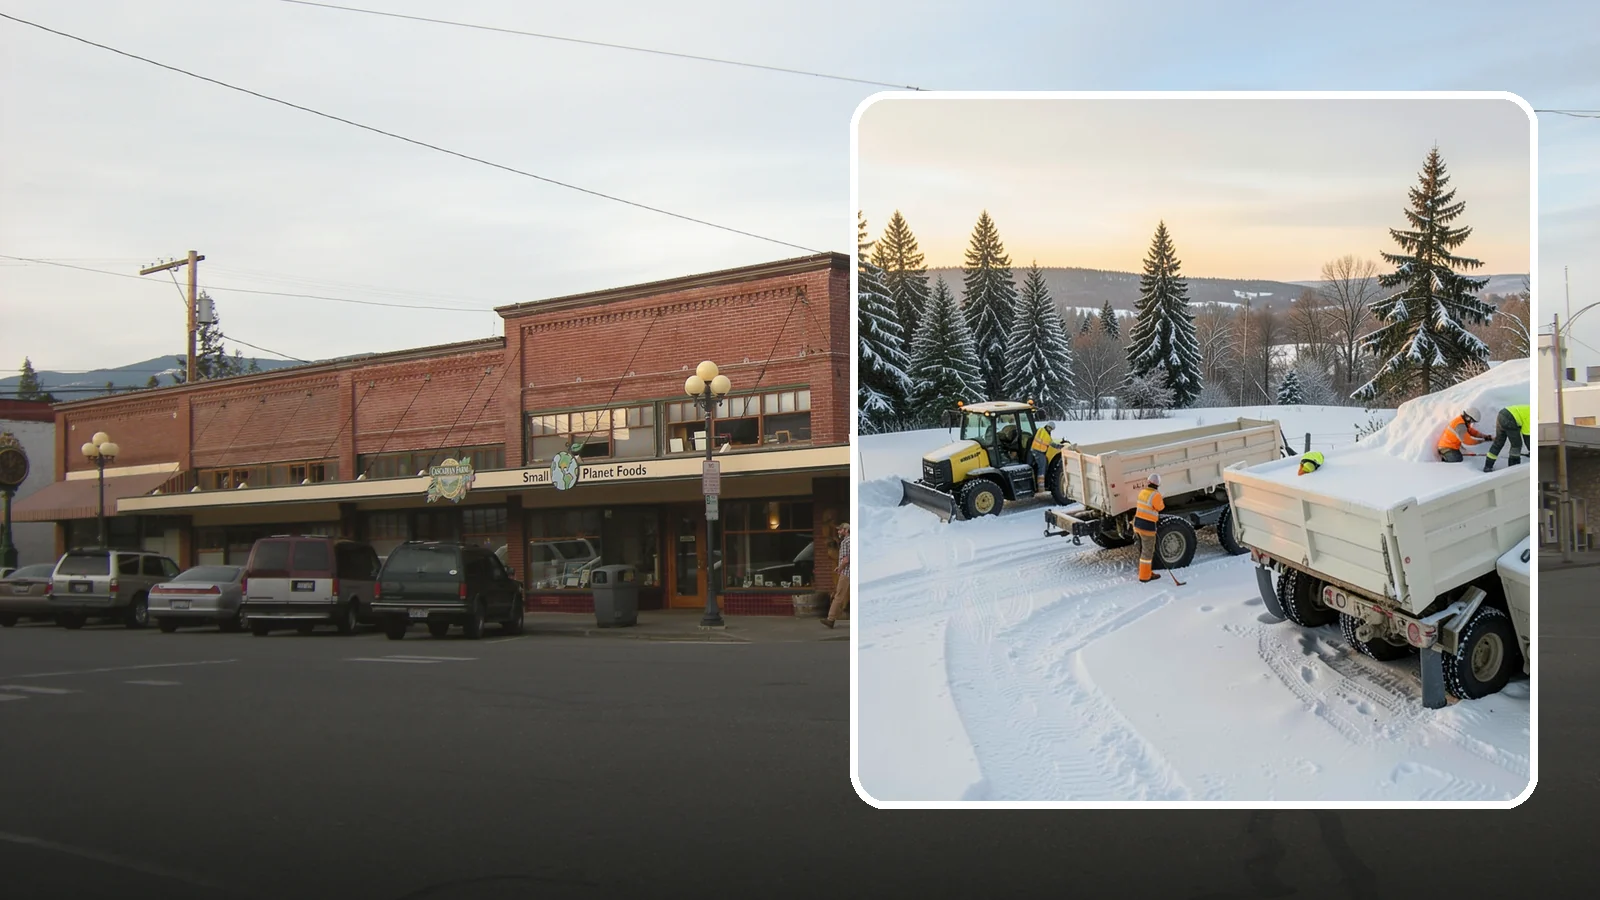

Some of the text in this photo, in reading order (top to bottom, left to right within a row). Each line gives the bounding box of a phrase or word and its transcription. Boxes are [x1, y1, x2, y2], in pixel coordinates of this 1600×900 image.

[523, 464, 647, 483] Small Planet Foods
